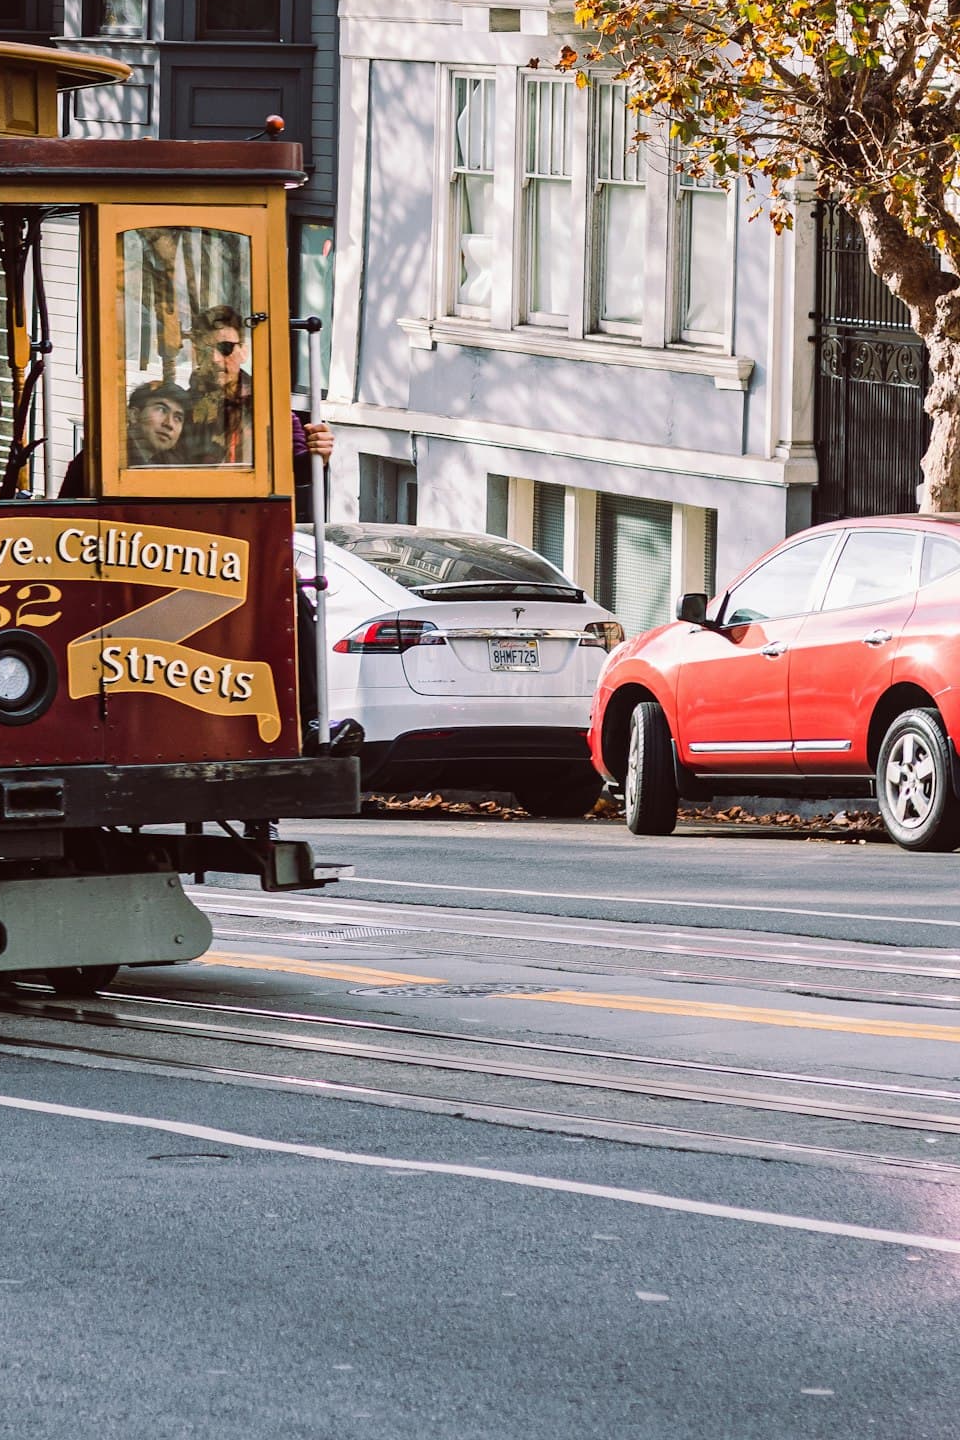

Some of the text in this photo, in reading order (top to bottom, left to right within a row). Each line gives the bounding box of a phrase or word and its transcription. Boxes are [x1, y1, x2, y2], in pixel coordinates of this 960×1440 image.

[56, 528, 242, 581] California
[101, 646, 255, 701] Streets
[494, 650, 536, 663] 8HMF725
